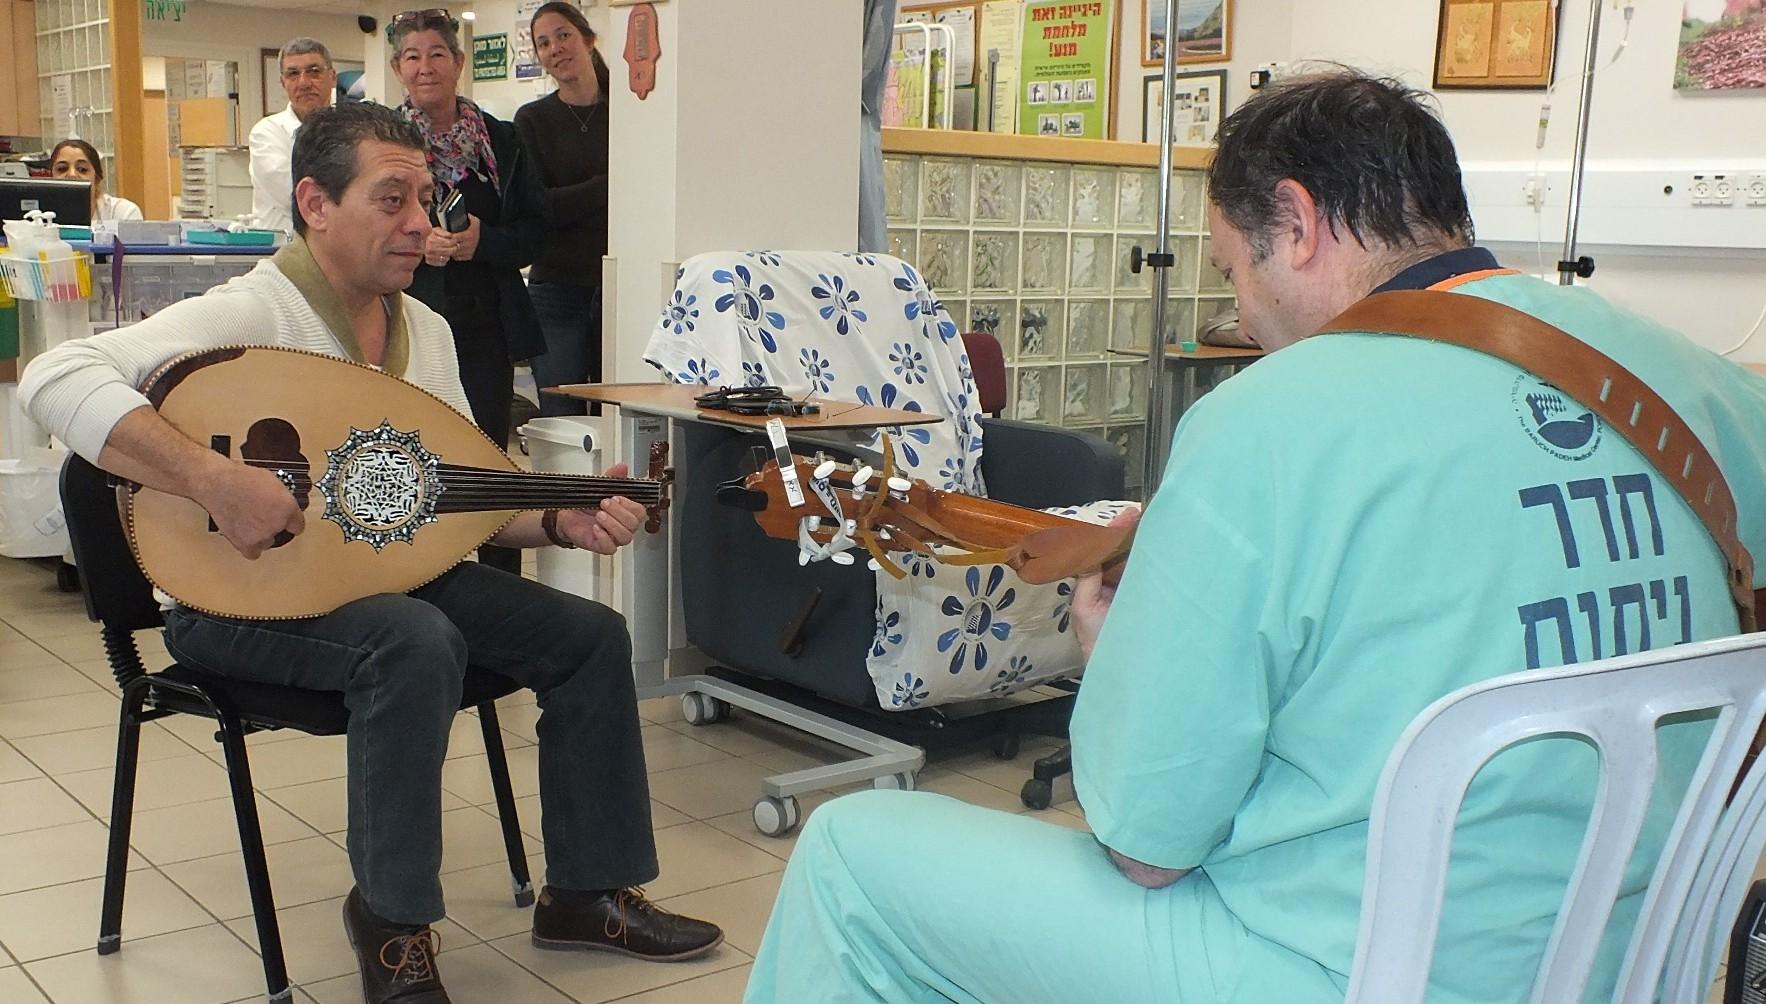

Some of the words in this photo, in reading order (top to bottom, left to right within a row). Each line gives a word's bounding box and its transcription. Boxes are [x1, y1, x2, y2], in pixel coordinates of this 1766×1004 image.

[146, 0, 186, 22] יציאה
[1032, 6, 1056, 22] זאת
[1059, 2, 1102, 20] היגיינה
[1042, 20, 1087, 40] מלחמת
[1049, 42, 1077, 58] מנע!
[1518, 473, 1665, 569] חדר
[1517, 575, 1692, 670] ניתוח
